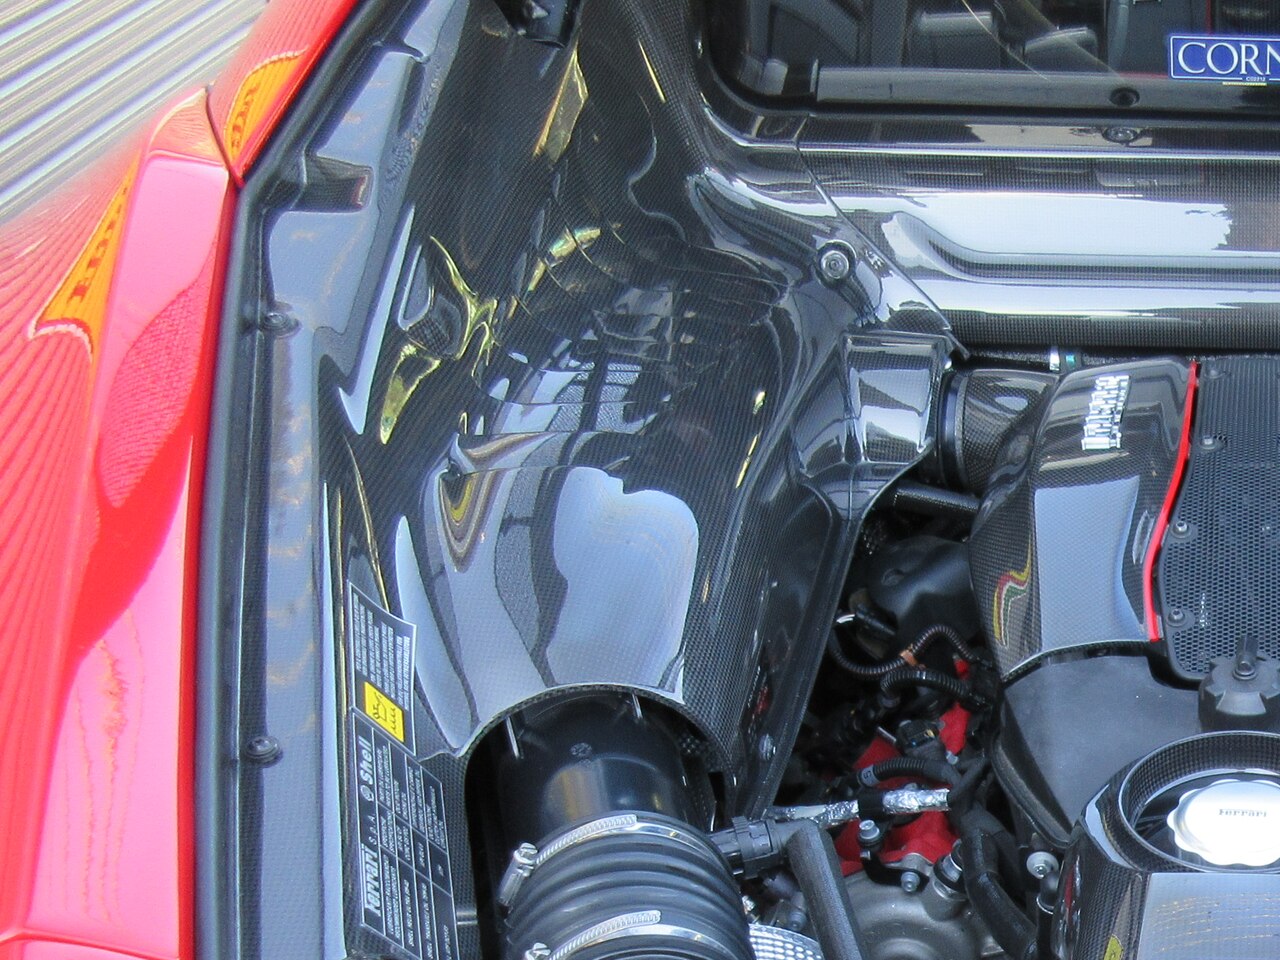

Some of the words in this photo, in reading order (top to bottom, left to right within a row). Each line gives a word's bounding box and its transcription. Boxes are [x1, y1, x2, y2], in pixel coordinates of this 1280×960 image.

[358, 733, 373, 787] Shell
[1218, 807, 1267, 817] Ferrari
[361, 842, 380, 917] Ferrari
